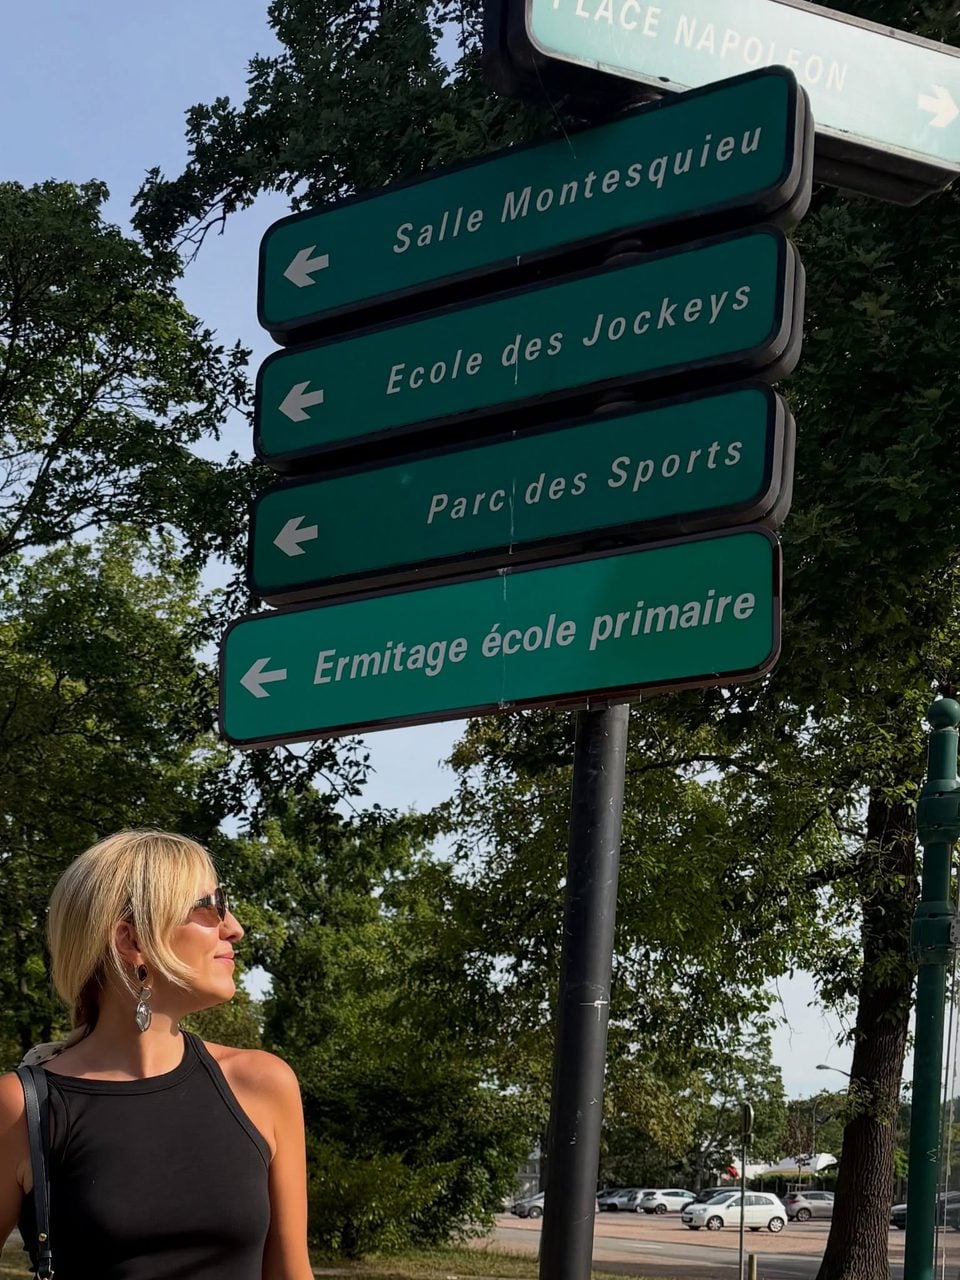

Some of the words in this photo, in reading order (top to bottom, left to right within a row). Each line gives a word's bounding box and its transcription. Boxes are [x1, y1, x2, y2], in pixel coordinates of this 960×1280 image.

[552, 0, 662, 38] LACE
[393, 207, 483, 254] Salle
[500, 127, 762, 223] Montesquieu
[386, 349, 483, 395] Ecole
[501, 331, 563, 367] des
[582, 284, 751, 347] Jockeys
[427, 488, 505, 524] Parc
[524, 472, 588, 505] des
[607, 440, 743, 492] Sports
[313, 636, 468, 685] Ermitage
[481, 613, 577, 658] école
[589, 589, 756, 651] primaire
